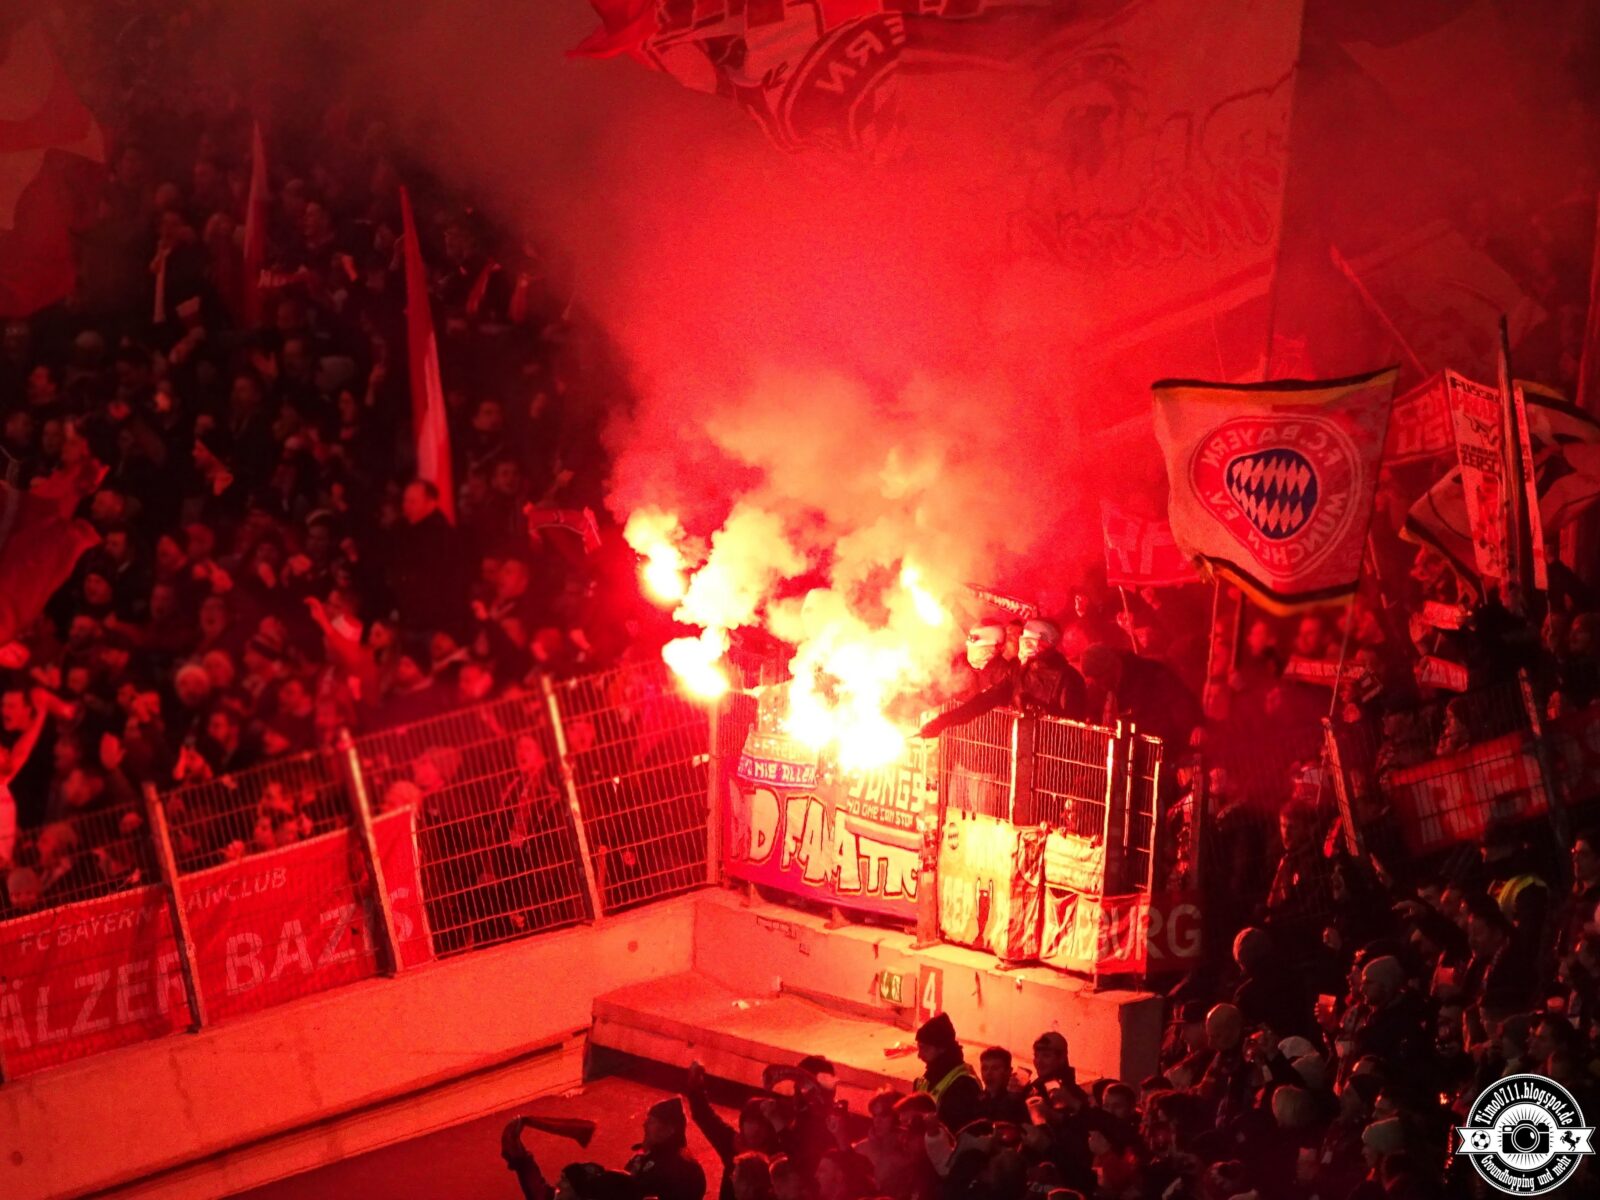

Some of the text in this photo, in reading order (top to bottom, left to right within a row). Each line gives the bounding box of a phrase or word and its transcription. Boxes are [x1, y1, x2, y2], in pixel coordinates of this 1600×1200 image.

[19, 930, 50, 954] FC
[186, 866, 288, 913] ANCLUB
[922, 971, 937, 1018] 4
